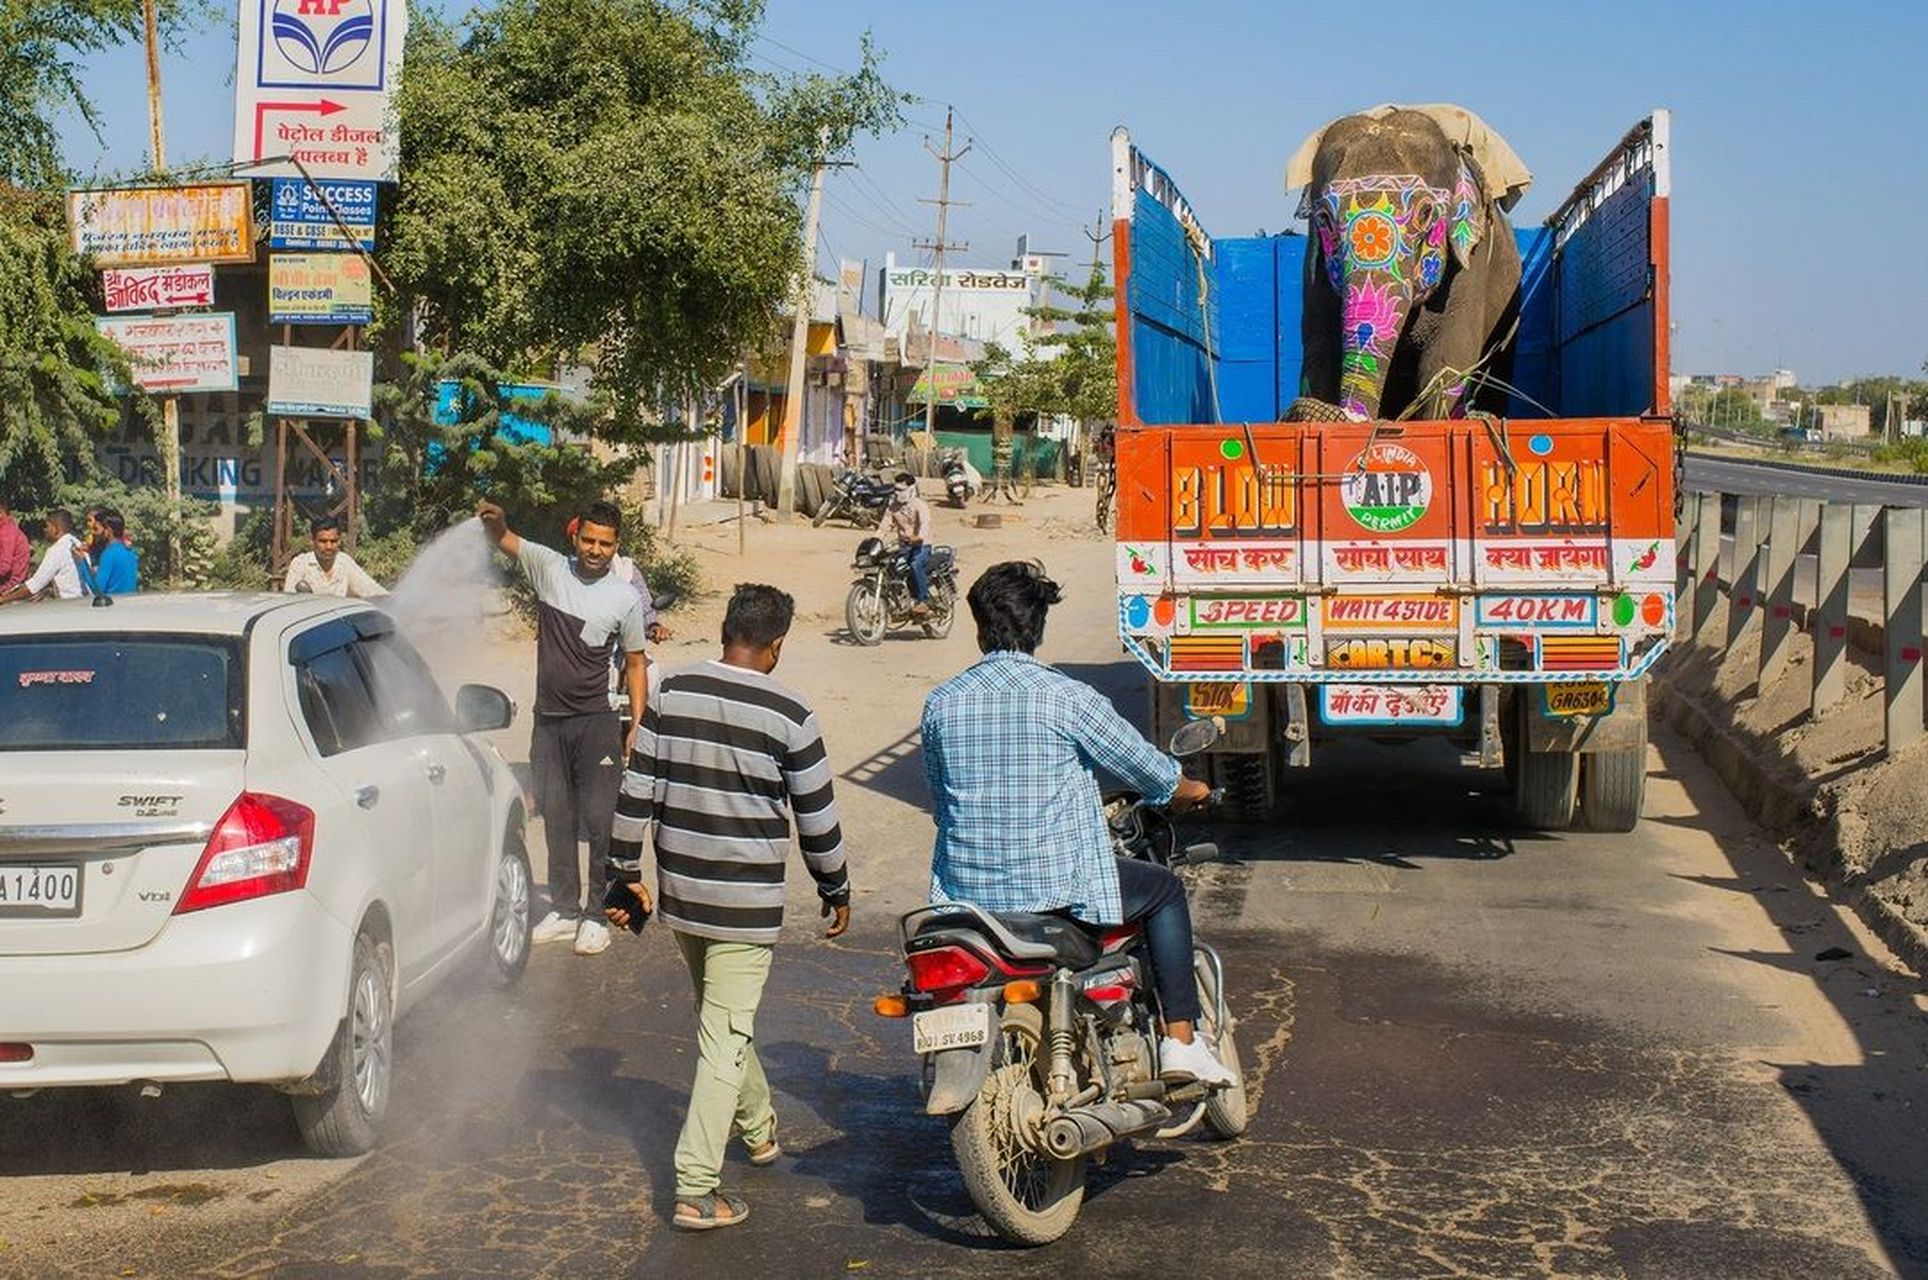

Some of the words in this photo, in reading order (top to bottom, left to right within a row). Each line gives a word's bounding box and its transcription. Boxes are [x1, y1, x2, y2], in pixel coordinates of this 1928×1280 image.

[277, 122, 324, 146] पेट्रोल
[330, 123, 381, 144] डीजल
[356, 147, 368, 165] है
[303, 184, 372, 203] SUCCESS
[957, 271, 1027, 289] रोडवेज
[1382, 446, 1417, 467] INDIA
[1172, 464, 1297, 537] BLOW
[1482, 459, 1608, 534] HORN
[1361, 507, 1418, 530] PERMIT
[1183, 543, 1239, 572] सोच
[1240, 548, 1294, 572] कर
[1392, 547, 1447, 573] साथ
[1485, 547, 1532, 571] क्या
[1533, 540, 1608, 572] जायेगा
[1200, 600, 1299, 622] SPEED
[117, 795, 183, 807] SWIFT
